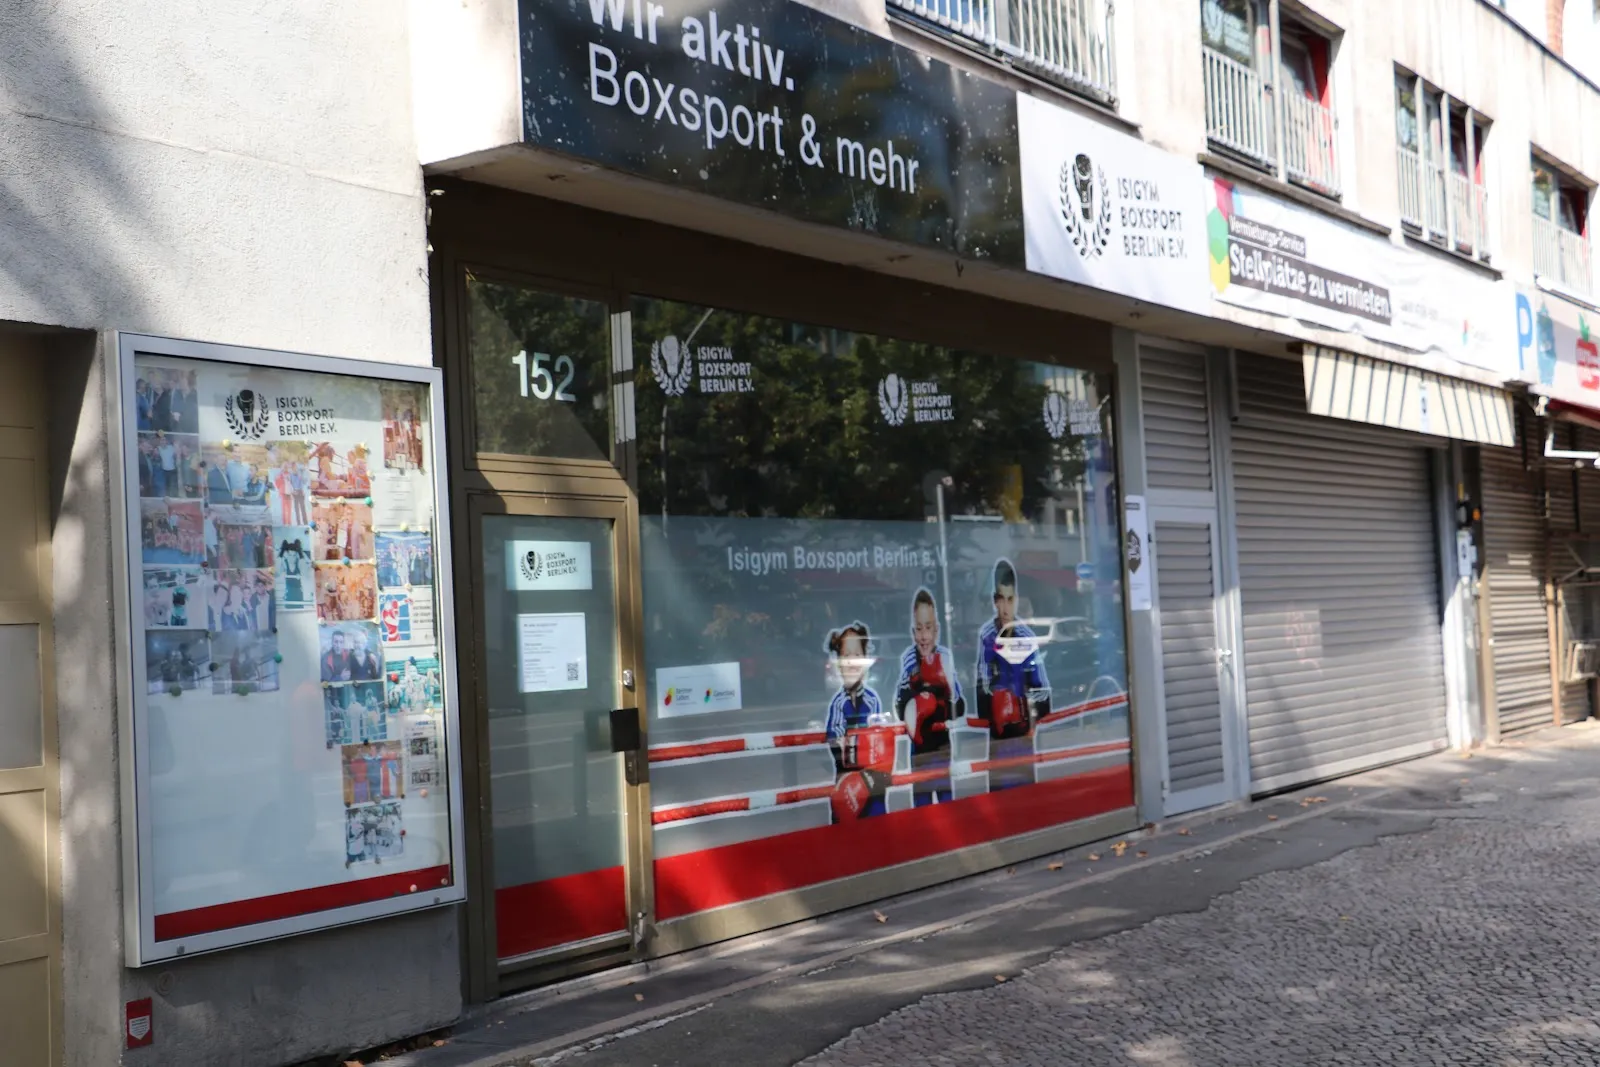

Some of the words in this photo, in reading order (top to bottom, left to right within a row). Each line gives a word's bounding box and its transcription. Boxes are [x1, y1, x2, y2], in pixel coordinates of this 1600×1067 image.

[681, 9, 795, 91] aktiv.
[589, 42, 784, 156] Boxsport
[799, 113, 825, 168] &
[837, 136, 920, 194] mehr
[1117, 177, 1160, 201] ISIGYM
[1120, 206, 1182, 232] BOXSPORT
[1123, 235, 1166, 257] BERLIN
[1229, 242, 1306, 293] Stellplätze
[1308, 273, 1326, 299] zu
[1516, 291, 1533, 370] P
[697, 346, 733, 360] ISIGYM
[511, 349, 577, 402] 152
[698, 362, 752, 376] BOXSPORT
[700, 378, 736, 393] BERLIN
[911, 382, 938, 394] ISIGYM
[275, 396, 314, 409] ISIGYM
[913, 394, 952, 408] BOXSPORT
[277, 409, 335, 422] BOXSPORT
[279, 424, 318, 436] BERLIN
[320, 422, 338, 434] E.V.
[727, 546, 788, 575] Isigym
[793, 546, 869, 574] Boxsport
[873, 545, 919, 568] Berlin
